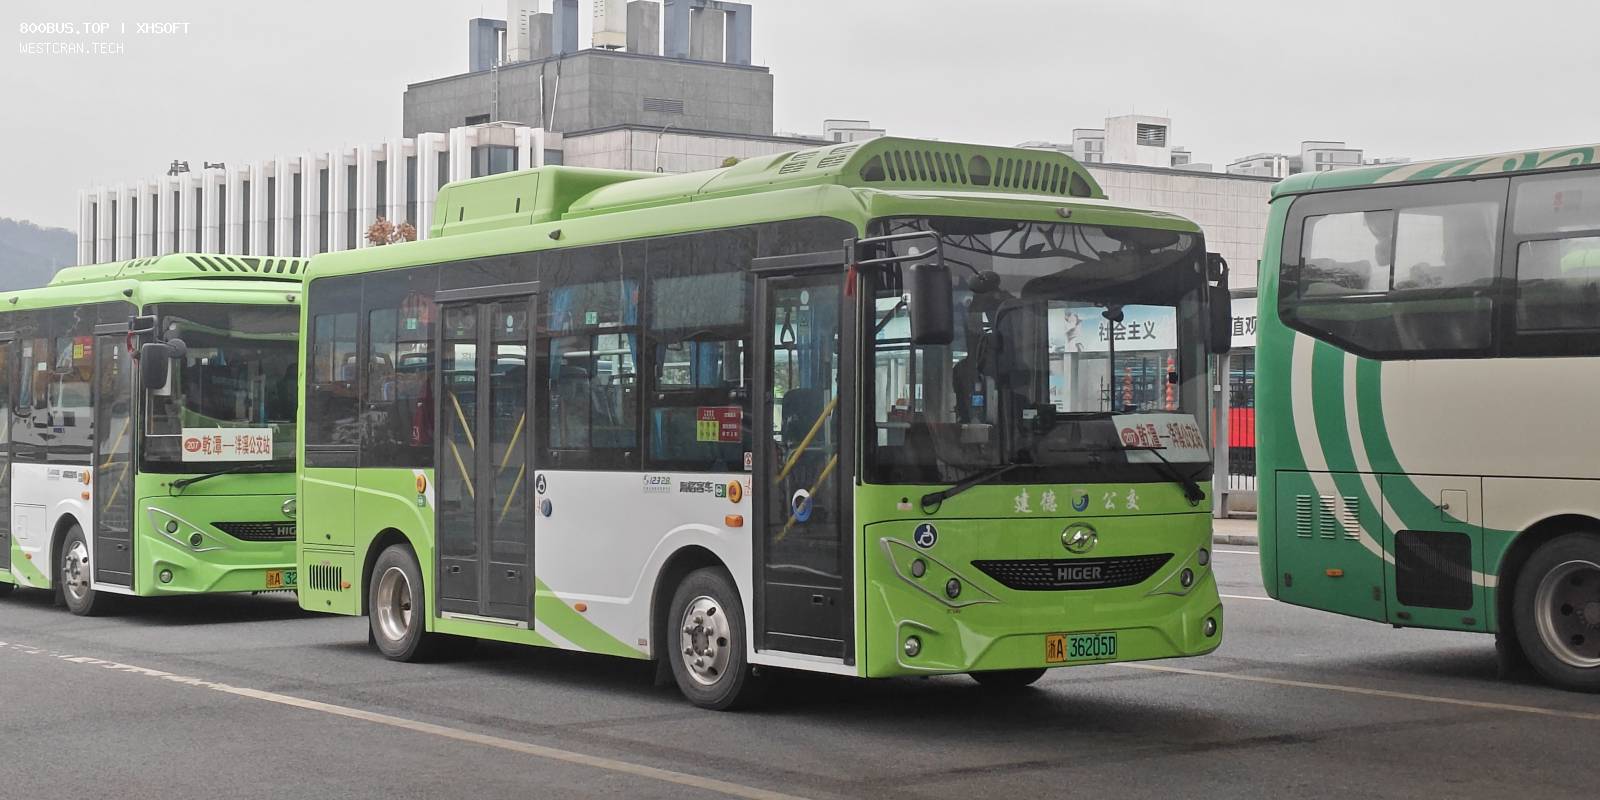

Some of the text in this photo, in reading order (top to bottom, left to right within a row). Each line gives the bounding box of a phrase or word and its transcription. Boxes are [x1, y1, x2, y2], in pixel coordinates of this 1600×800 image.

[1099, 320, 1156, 342] 社会主义
[1014, 488, 1140, 512] 建德 公交
[1057, 566, 1102, 580] HIGER
[1047, 636, 1116, 658] 浙A 36205D
